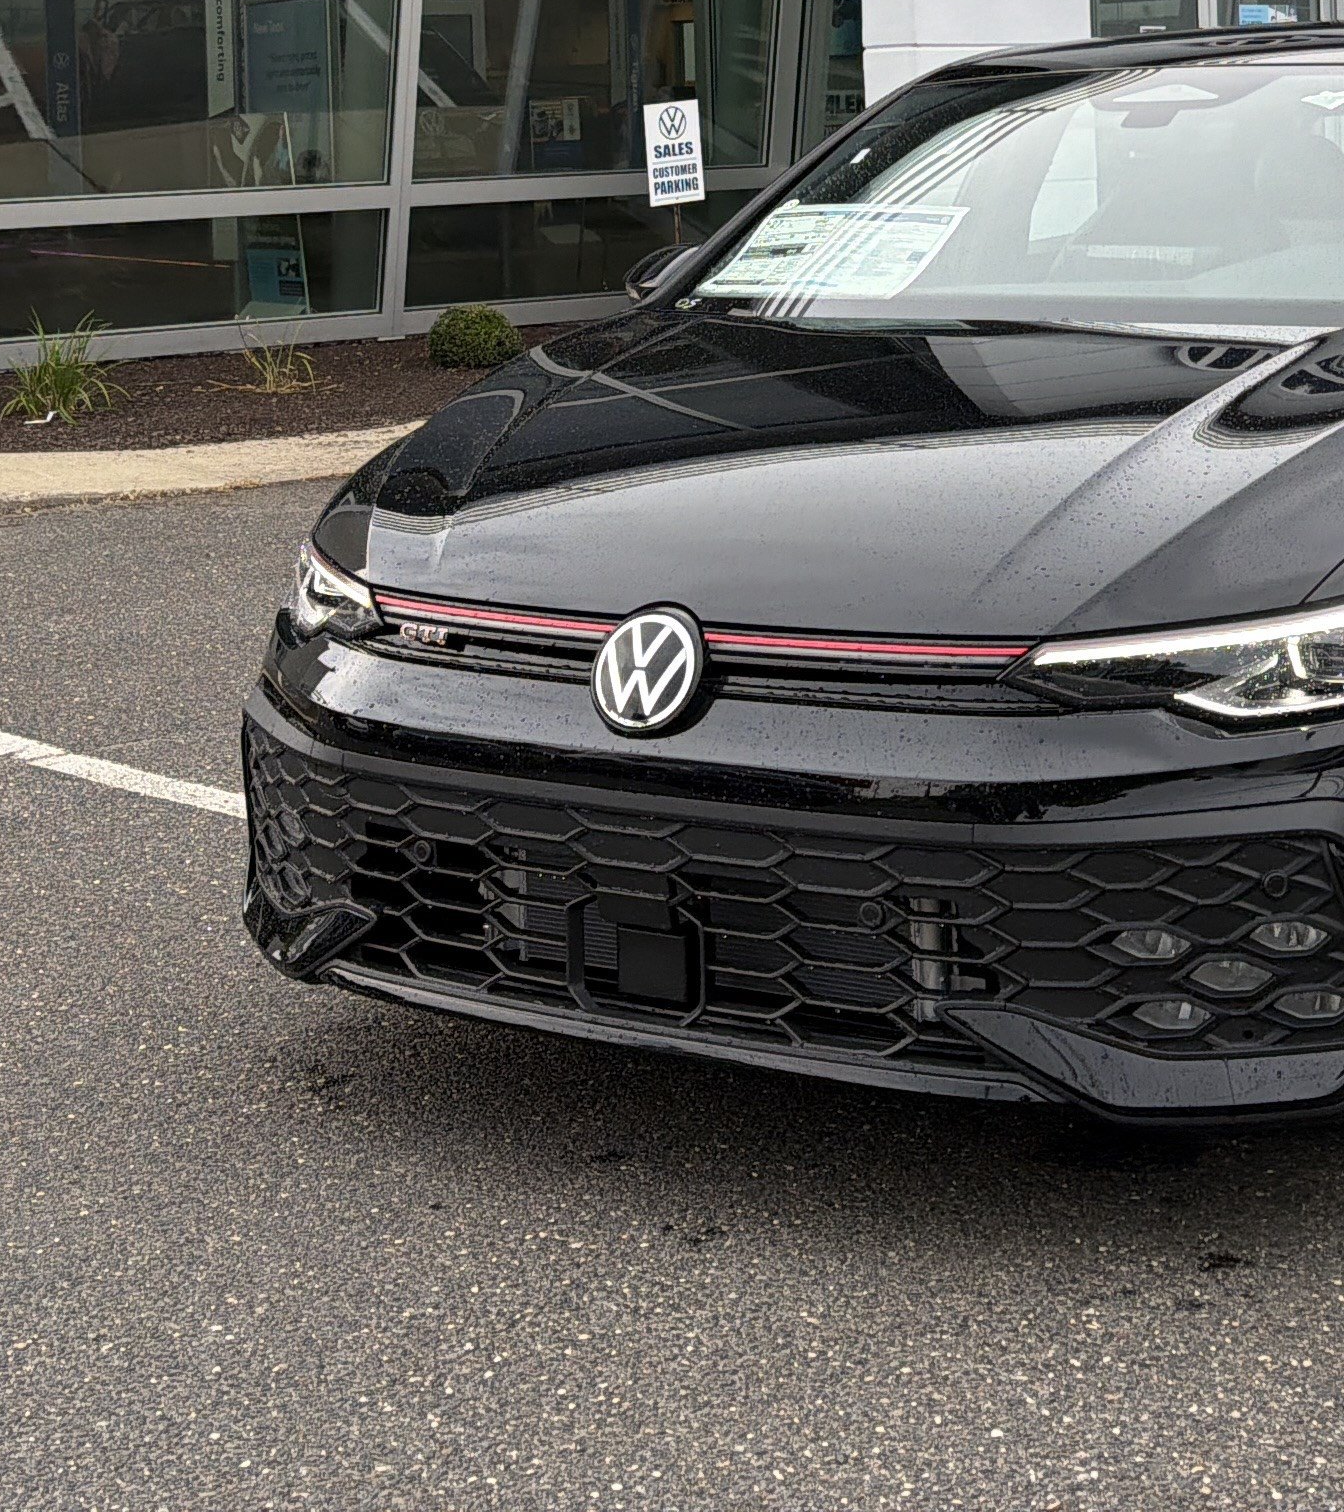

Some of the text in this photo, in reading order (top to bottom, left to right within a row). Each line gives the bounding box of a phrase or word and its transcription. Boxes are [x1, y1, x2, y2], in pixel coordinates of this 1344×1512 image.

[56, 82, 70, 122] Atlas
[654, 141, 694, 158] SALES
[653, 162, 698, 179] CUSTOMER
[654, 177, 699, 195] PARKING
[399, 622, 448, 646] GTI
